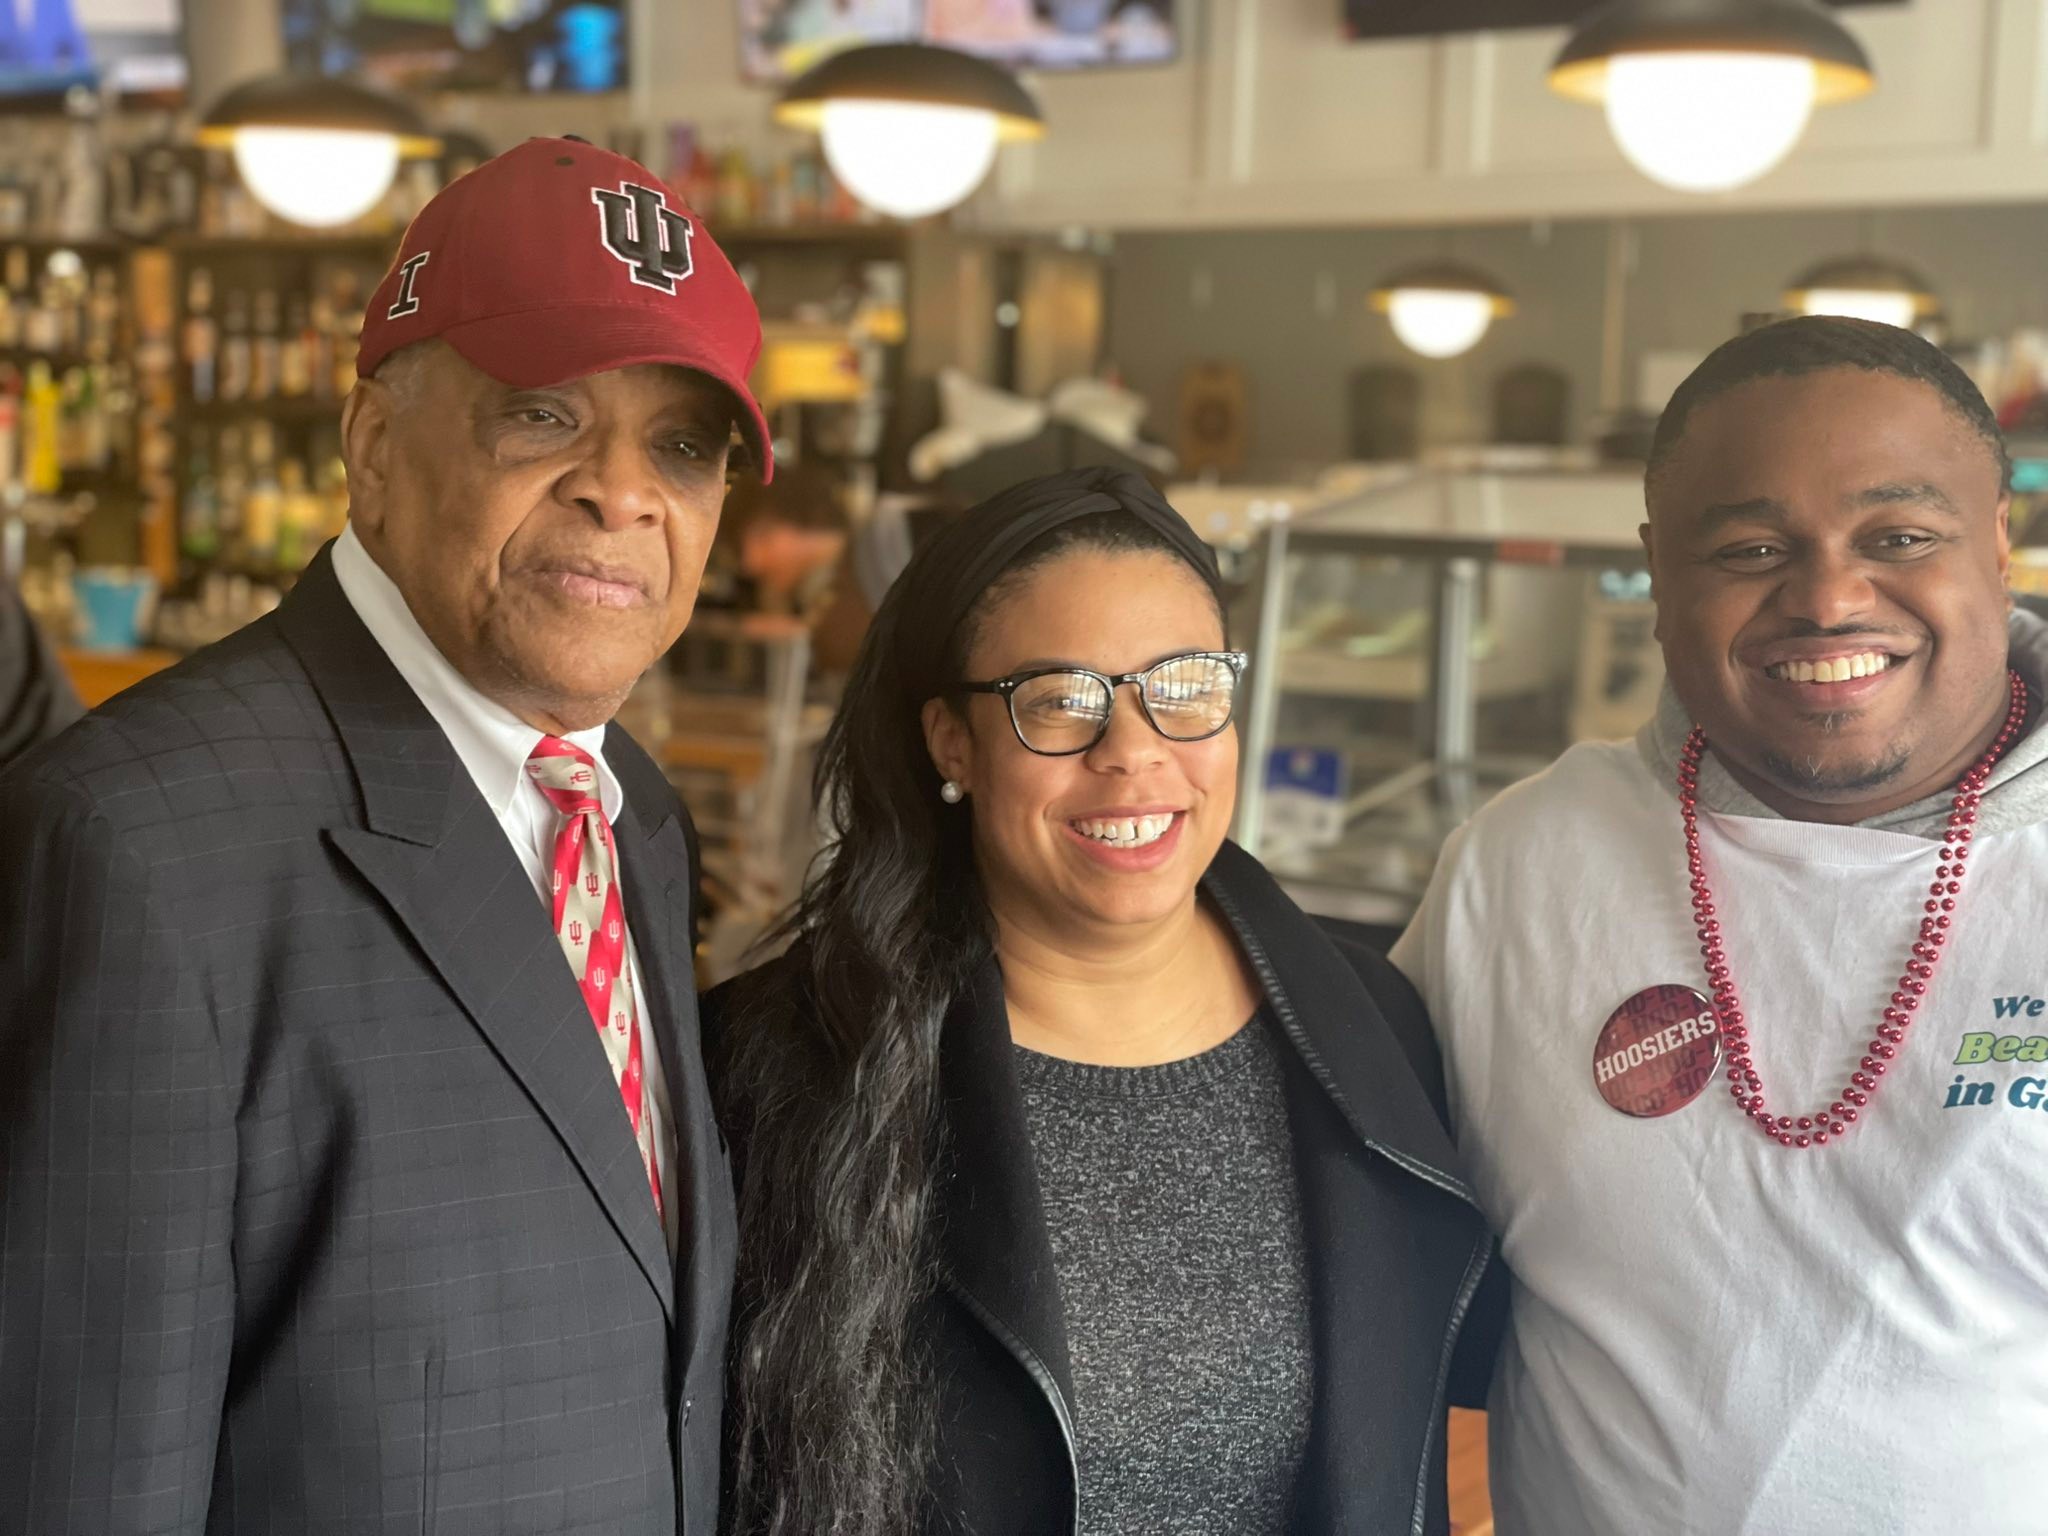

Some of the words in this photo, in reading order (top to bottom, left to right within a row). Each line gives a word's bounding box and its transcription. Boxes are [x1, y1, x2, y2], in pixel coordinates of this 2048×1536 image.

[387, 251, 430, 320] I
[1992, 995, 2046, 1019] We
[1596, 1011, 1716, 1084] HOOSIERS
[1943, 1074, 1995, 1108] in
[2008, 1076, 2048, 1112] G
